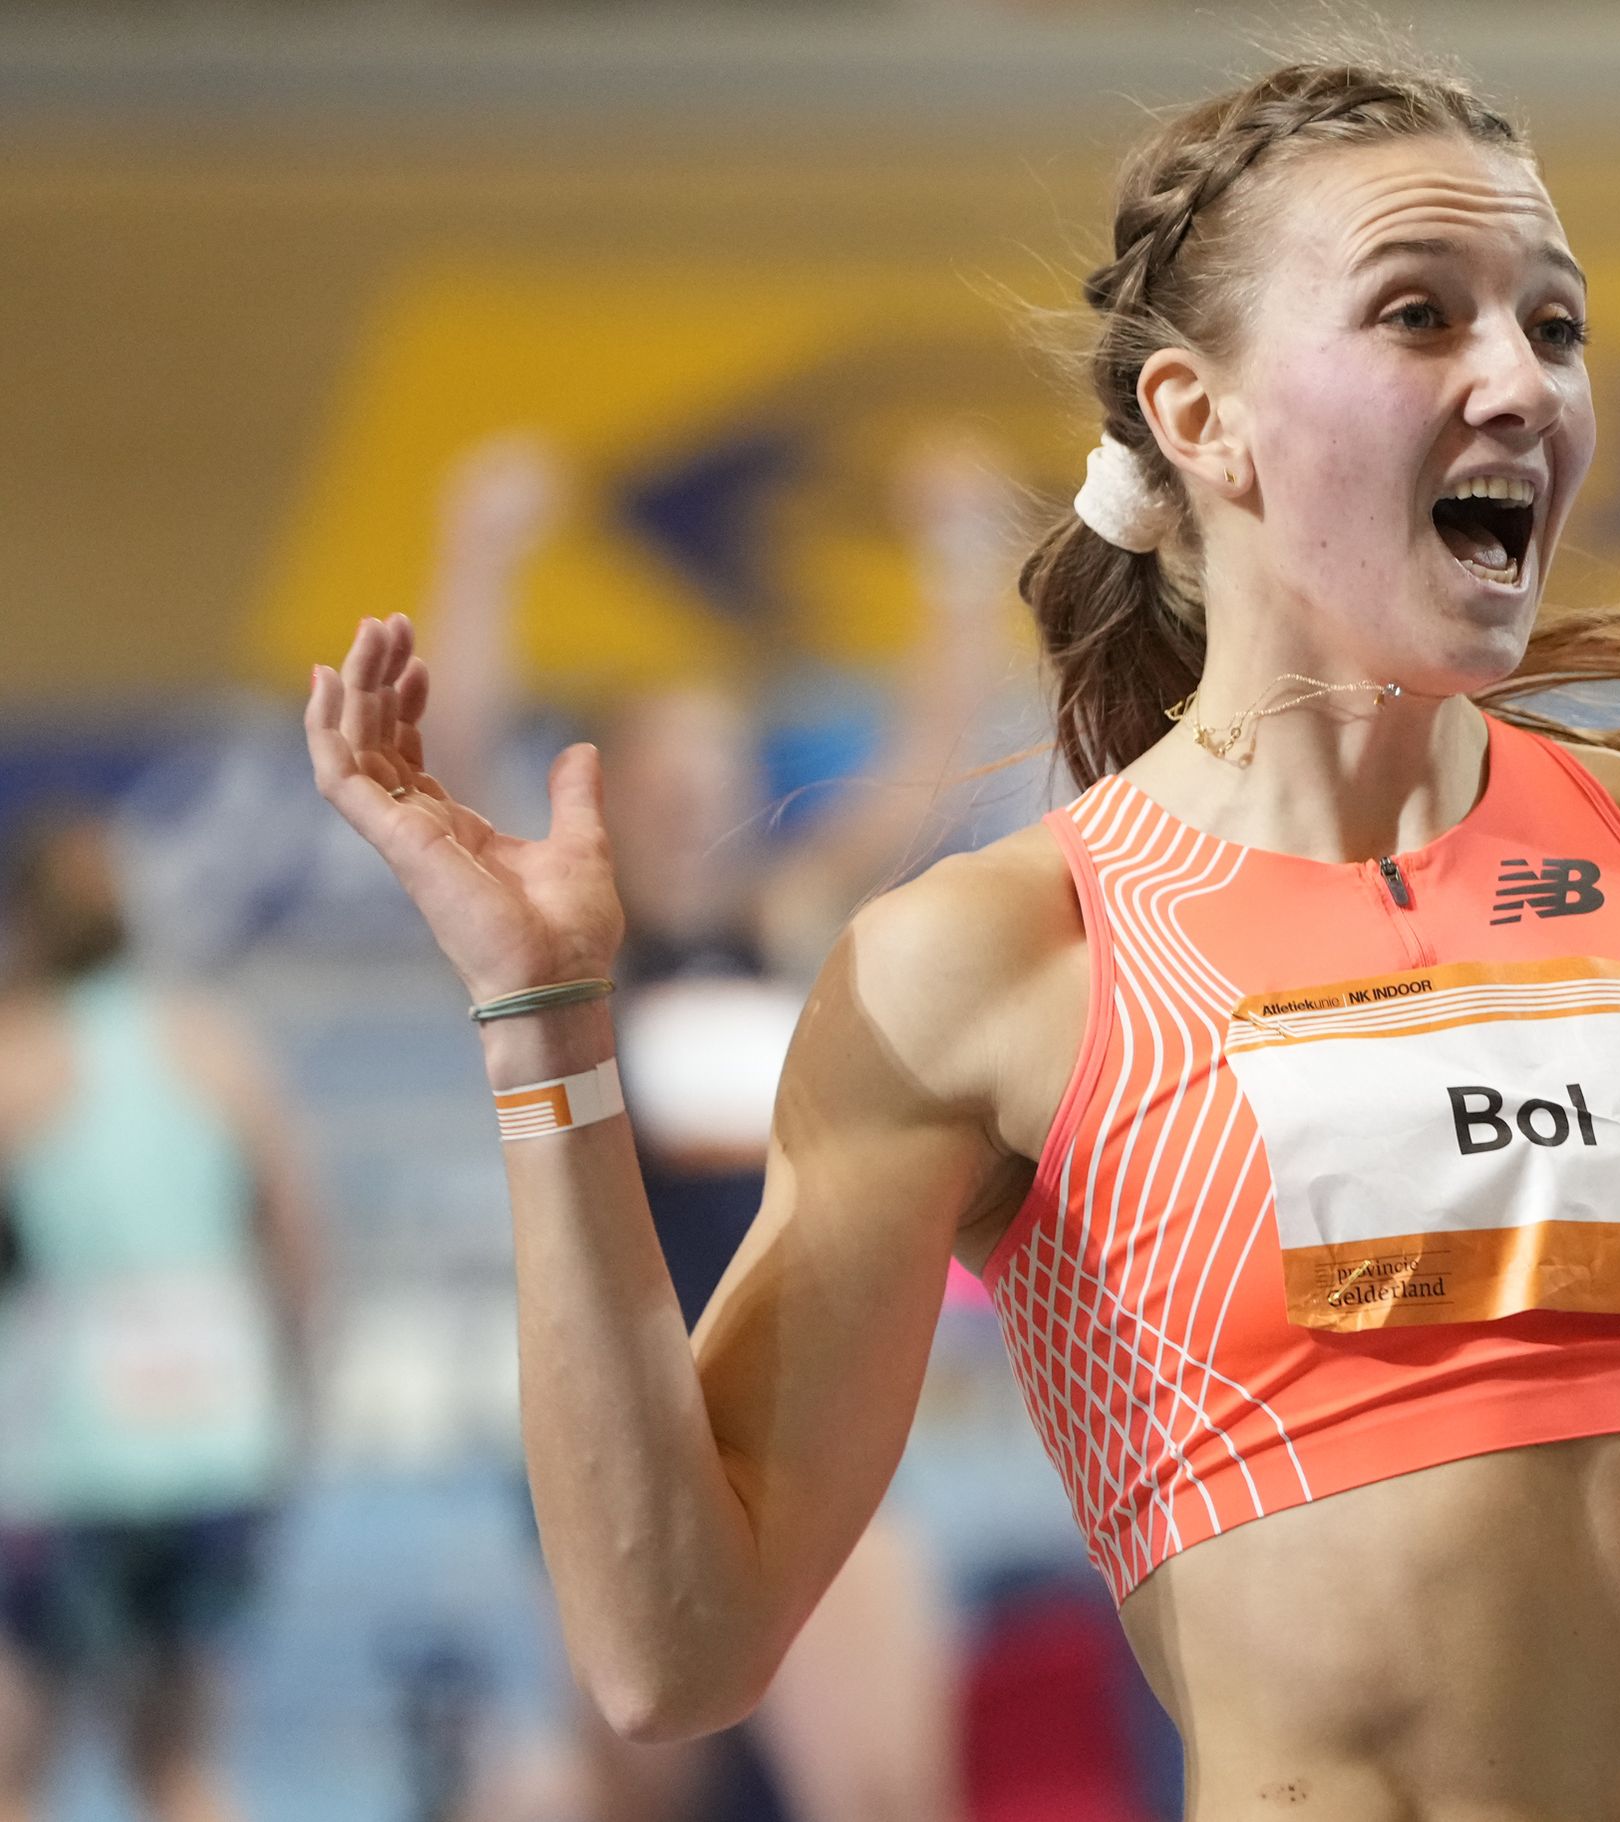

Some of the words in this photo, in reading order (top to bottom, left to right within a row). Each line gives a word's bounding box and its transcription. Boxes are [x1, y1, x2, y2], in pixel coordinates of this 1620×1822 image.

[1489, 858, 1605, 926] NB
[1262, 997, 1340, 1017] Atletiekunie
[1349, 989, 1369, 1004] NK
[1373, 979, 1432, 1000] INDOOR
[1446, 1083, 1597, 1155] Bol
[1328, 1277, 1446, 1308] Gelderland
